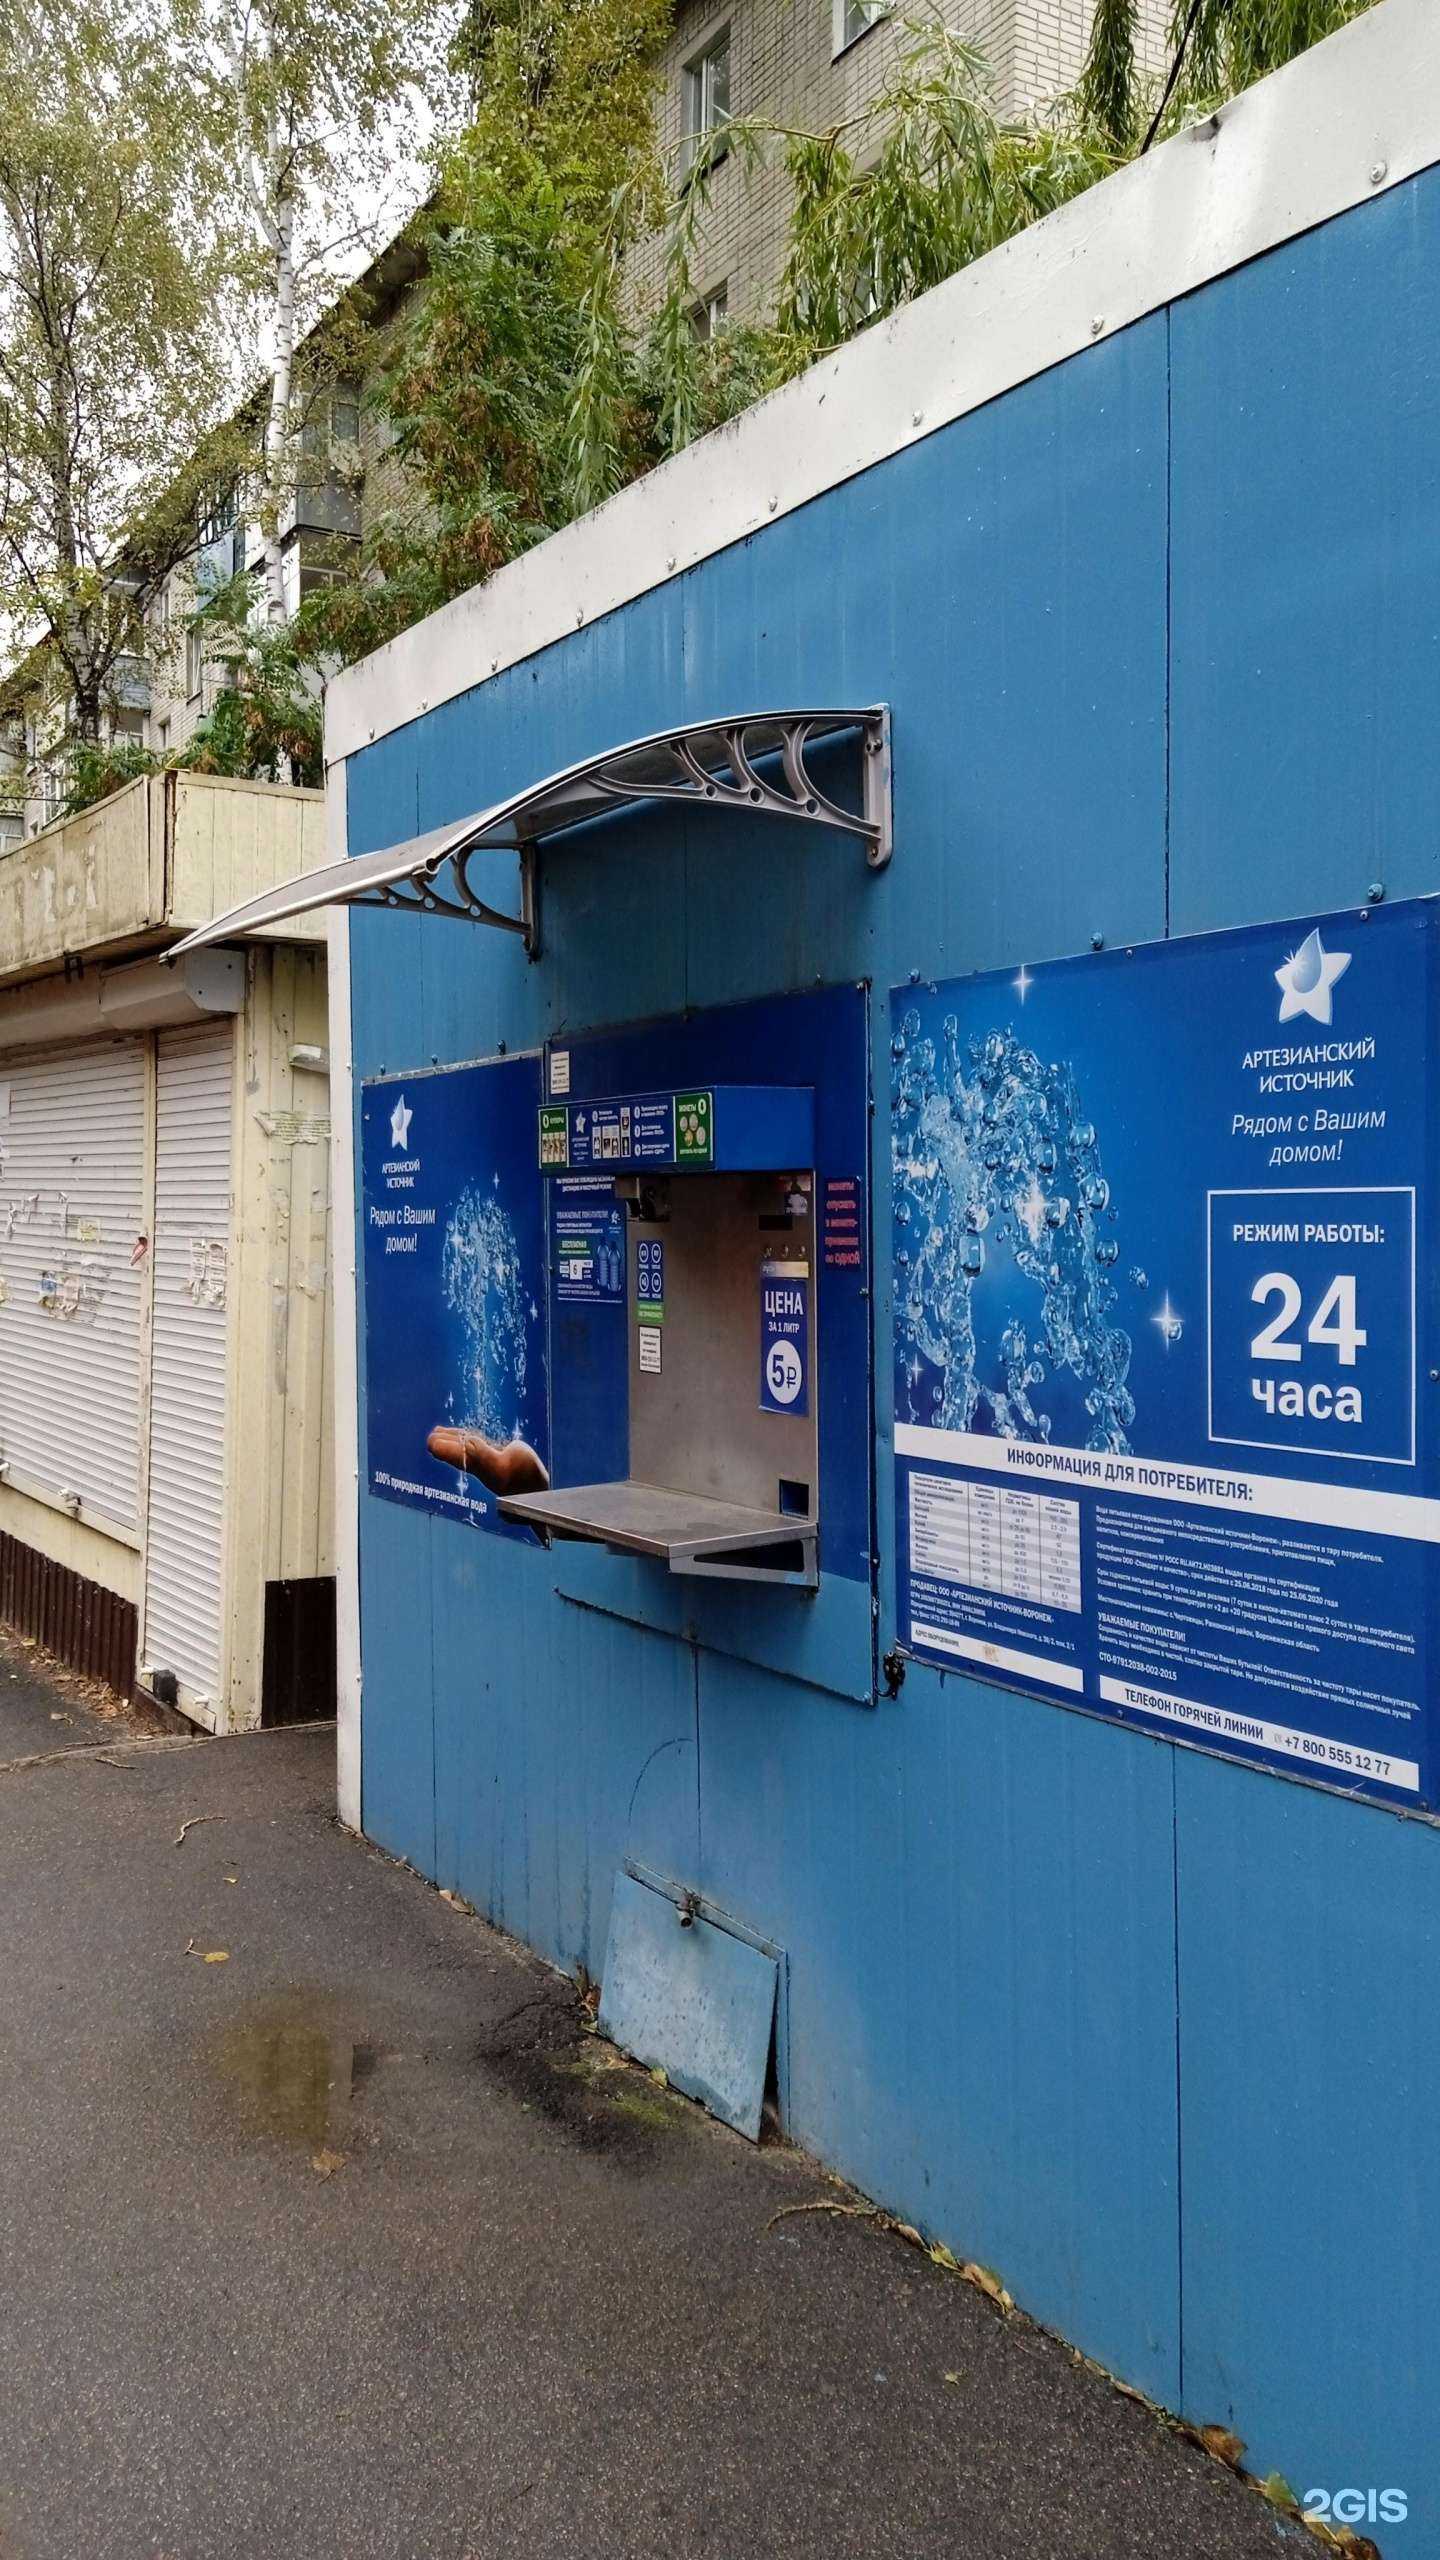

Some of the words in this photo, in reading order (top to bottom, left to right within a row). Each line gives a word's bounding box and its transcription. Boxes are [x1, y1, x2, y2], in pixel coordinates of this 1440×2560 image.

[1242, 1037, 1376, 1070] АРТЕЗИАНСКИЙ
[1259, 1068, 1354, 1094] ИСТОЧНИК
[1231, 1112, 1292, 1138] Рядом
[1298, 1115, 1309, 1133] с
[1314, 1108, 1386, 1131] Вашим
[1268, 1140, 1343, 1167] домом!
[370, 1206, 395, 1228] Рядом
[397, 1212, 403, 1225] с
[404, 1205, 436, 1225] Вашим
[385, 1233, 418, 1254] домом!
[1232, 1223, 1300, 1244] РЕЖИМ
[1304, 1222, 1385, 1244] РАБОТЫ:
[764, 1290, 804, 1317] ЦЕНА
[768, 1321, 777, 1332] ЗА
[783, 1322, 800, 1334] ЛИТР
[1249, 1272, 1367, 1366] 24
[1251, 1377, 1364, 1424] часа
[1006, 1447, 1102, 1480] ИНФОРМАЦИЯ
[1103, 1461, 1134, 1486] ДЛЯ
[1137, 1466, 1254, 1502] ПОТРЕБИТЕЛЯ:
[375, 1471, 391, 1486] 100%
[471, 1498, 488, 1515] вода
[1124, 1687, 1172, 1715] ТЕЛЕФОН
[1172, 1698, 1222, 1728] ГОРЯЧЕЙ
[1223, 1714, 1264, 1741] ЛИНИИ
[1284, 1734, 1300, 1751] +7
[1302, 1736, 1327, 1759] 800
[1328, 1743, 1353, 1765] 555
[1355, 1750, 1373, 1771] 12
[1374, 1756, 1392, 1777] 77
